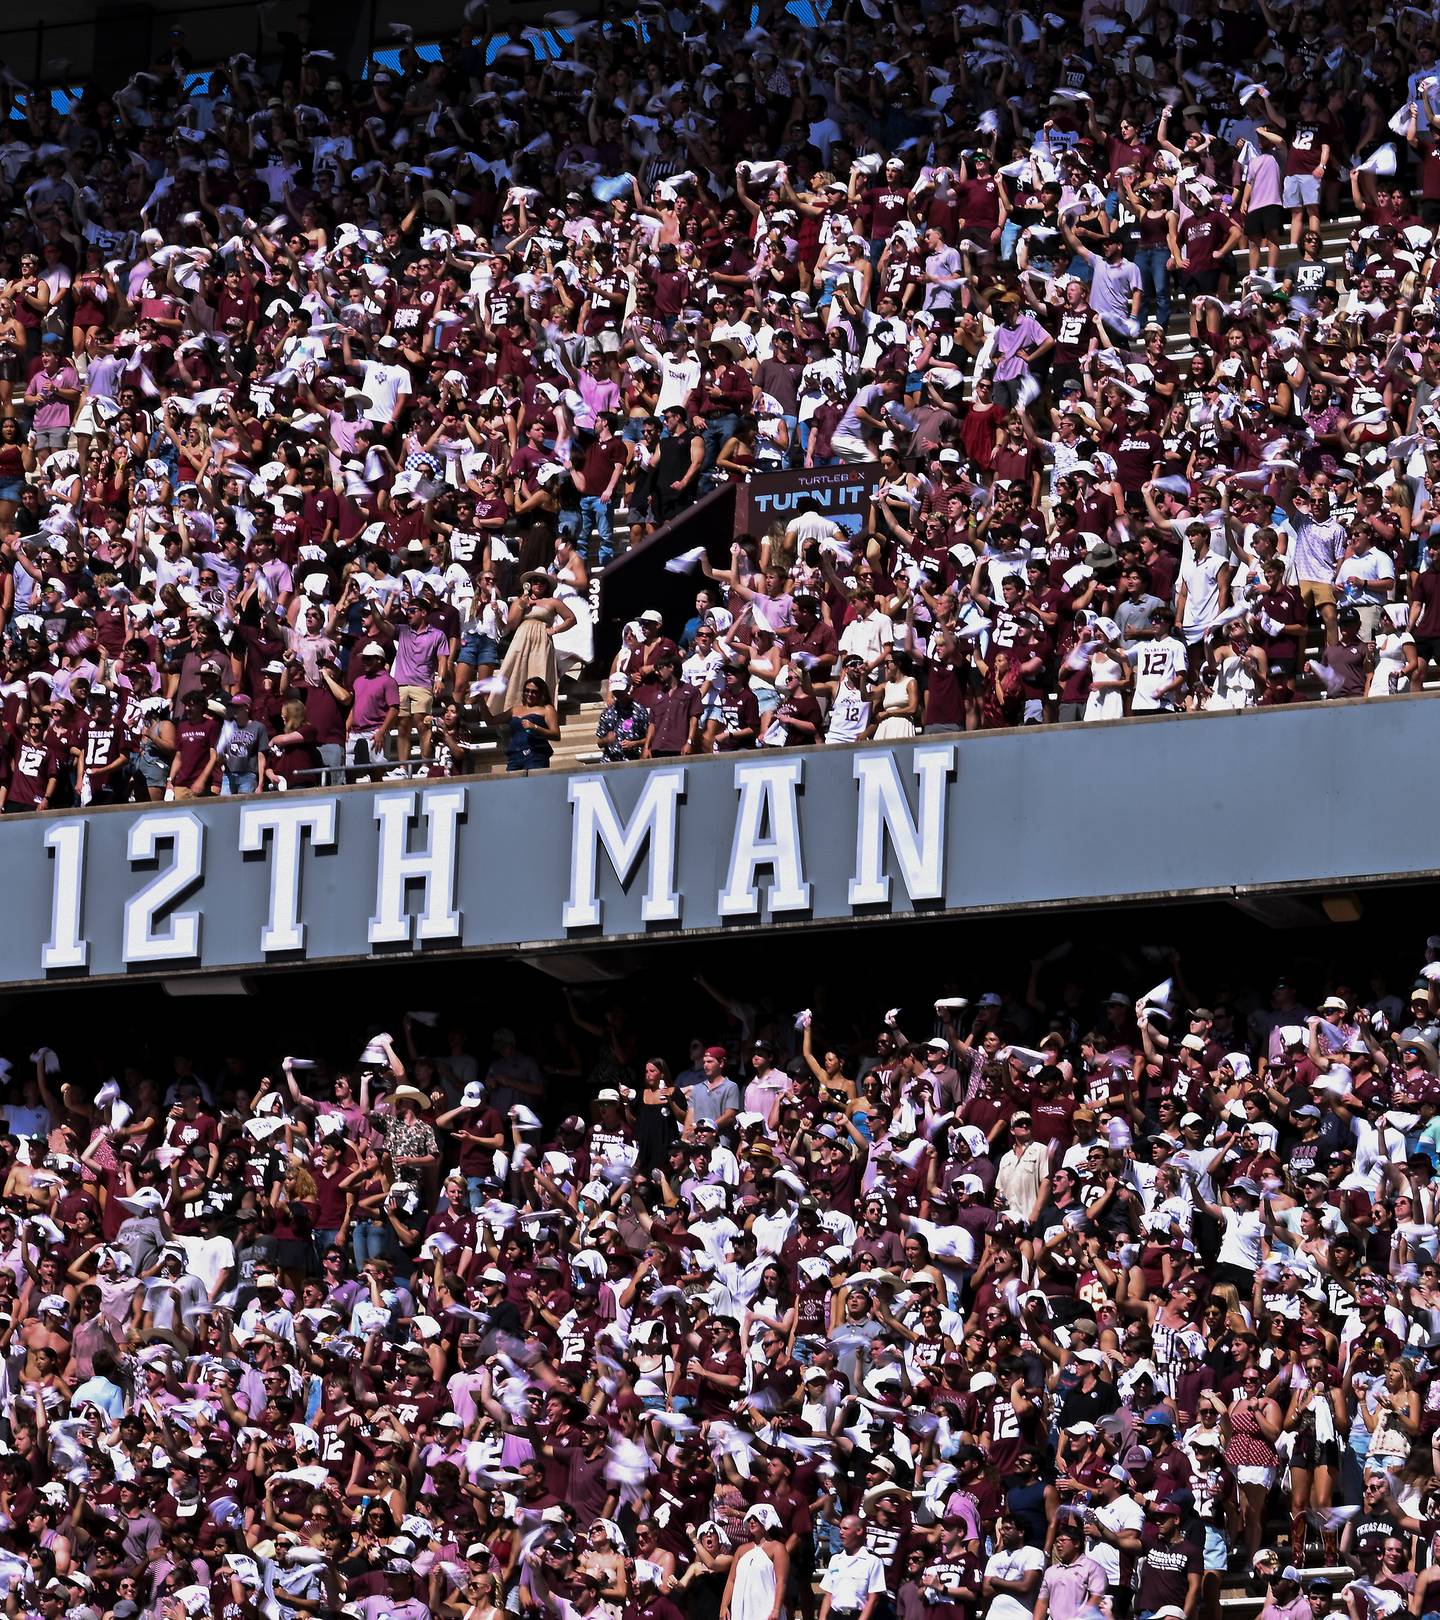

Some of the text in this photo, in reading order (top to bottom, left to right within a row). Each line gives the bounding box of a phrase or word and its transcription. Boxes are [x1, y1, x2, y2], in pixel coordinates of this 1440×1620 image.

[1292, 130, 1314, 150] 12
[492, 303, 508, 324] 12
[1058, 322, 1082, 344] 12
[839, 485, 865, 505] IT
[463, 580, 472, 588] 12
[992, 619, 1016, 649] 12
[1142, 654, 1168, 676] 12
[845, 708, 860, 722] 12
[86, 737, 111, 765] 12
[18, 750, 43, 777] 12
[41, 786, 468, 969] 12TH
[562, 745, 957, 928] MAN
[1327, 1289, 1355, 1314] 12
[560, 1338, 585, 1364] 12
[993, 1409, 1019, 1441] 12
[323, 1433, 345, 1460] 12
[1356, 1522, 1377, 1536] TEXAS
